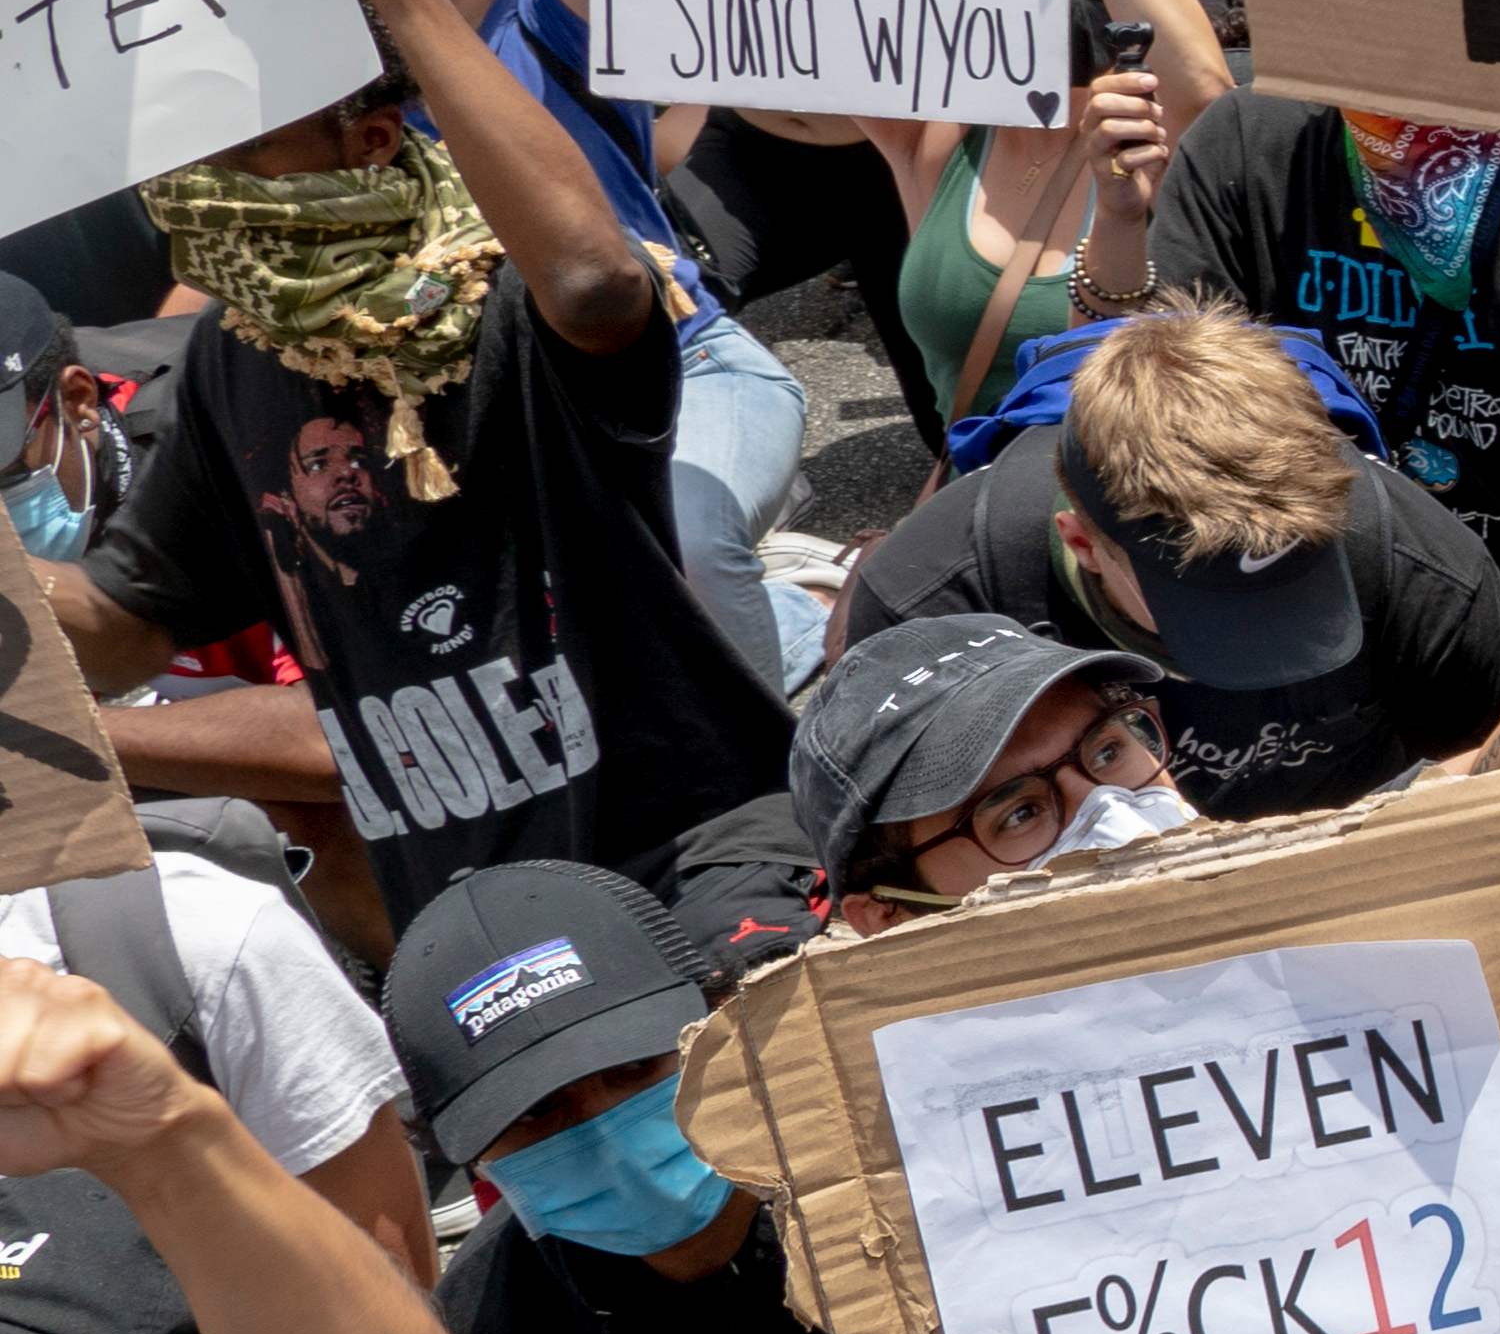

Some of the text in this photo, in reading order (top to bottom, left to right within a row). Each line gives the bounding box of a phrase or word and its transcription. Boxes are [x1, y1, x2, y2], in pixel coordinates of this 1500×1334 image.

[400, 583, 466, 633] EVERYBODY
[466, 967, 583, 1038] patagonia
[980, 1017, 1448, 1215] ELEVEN
